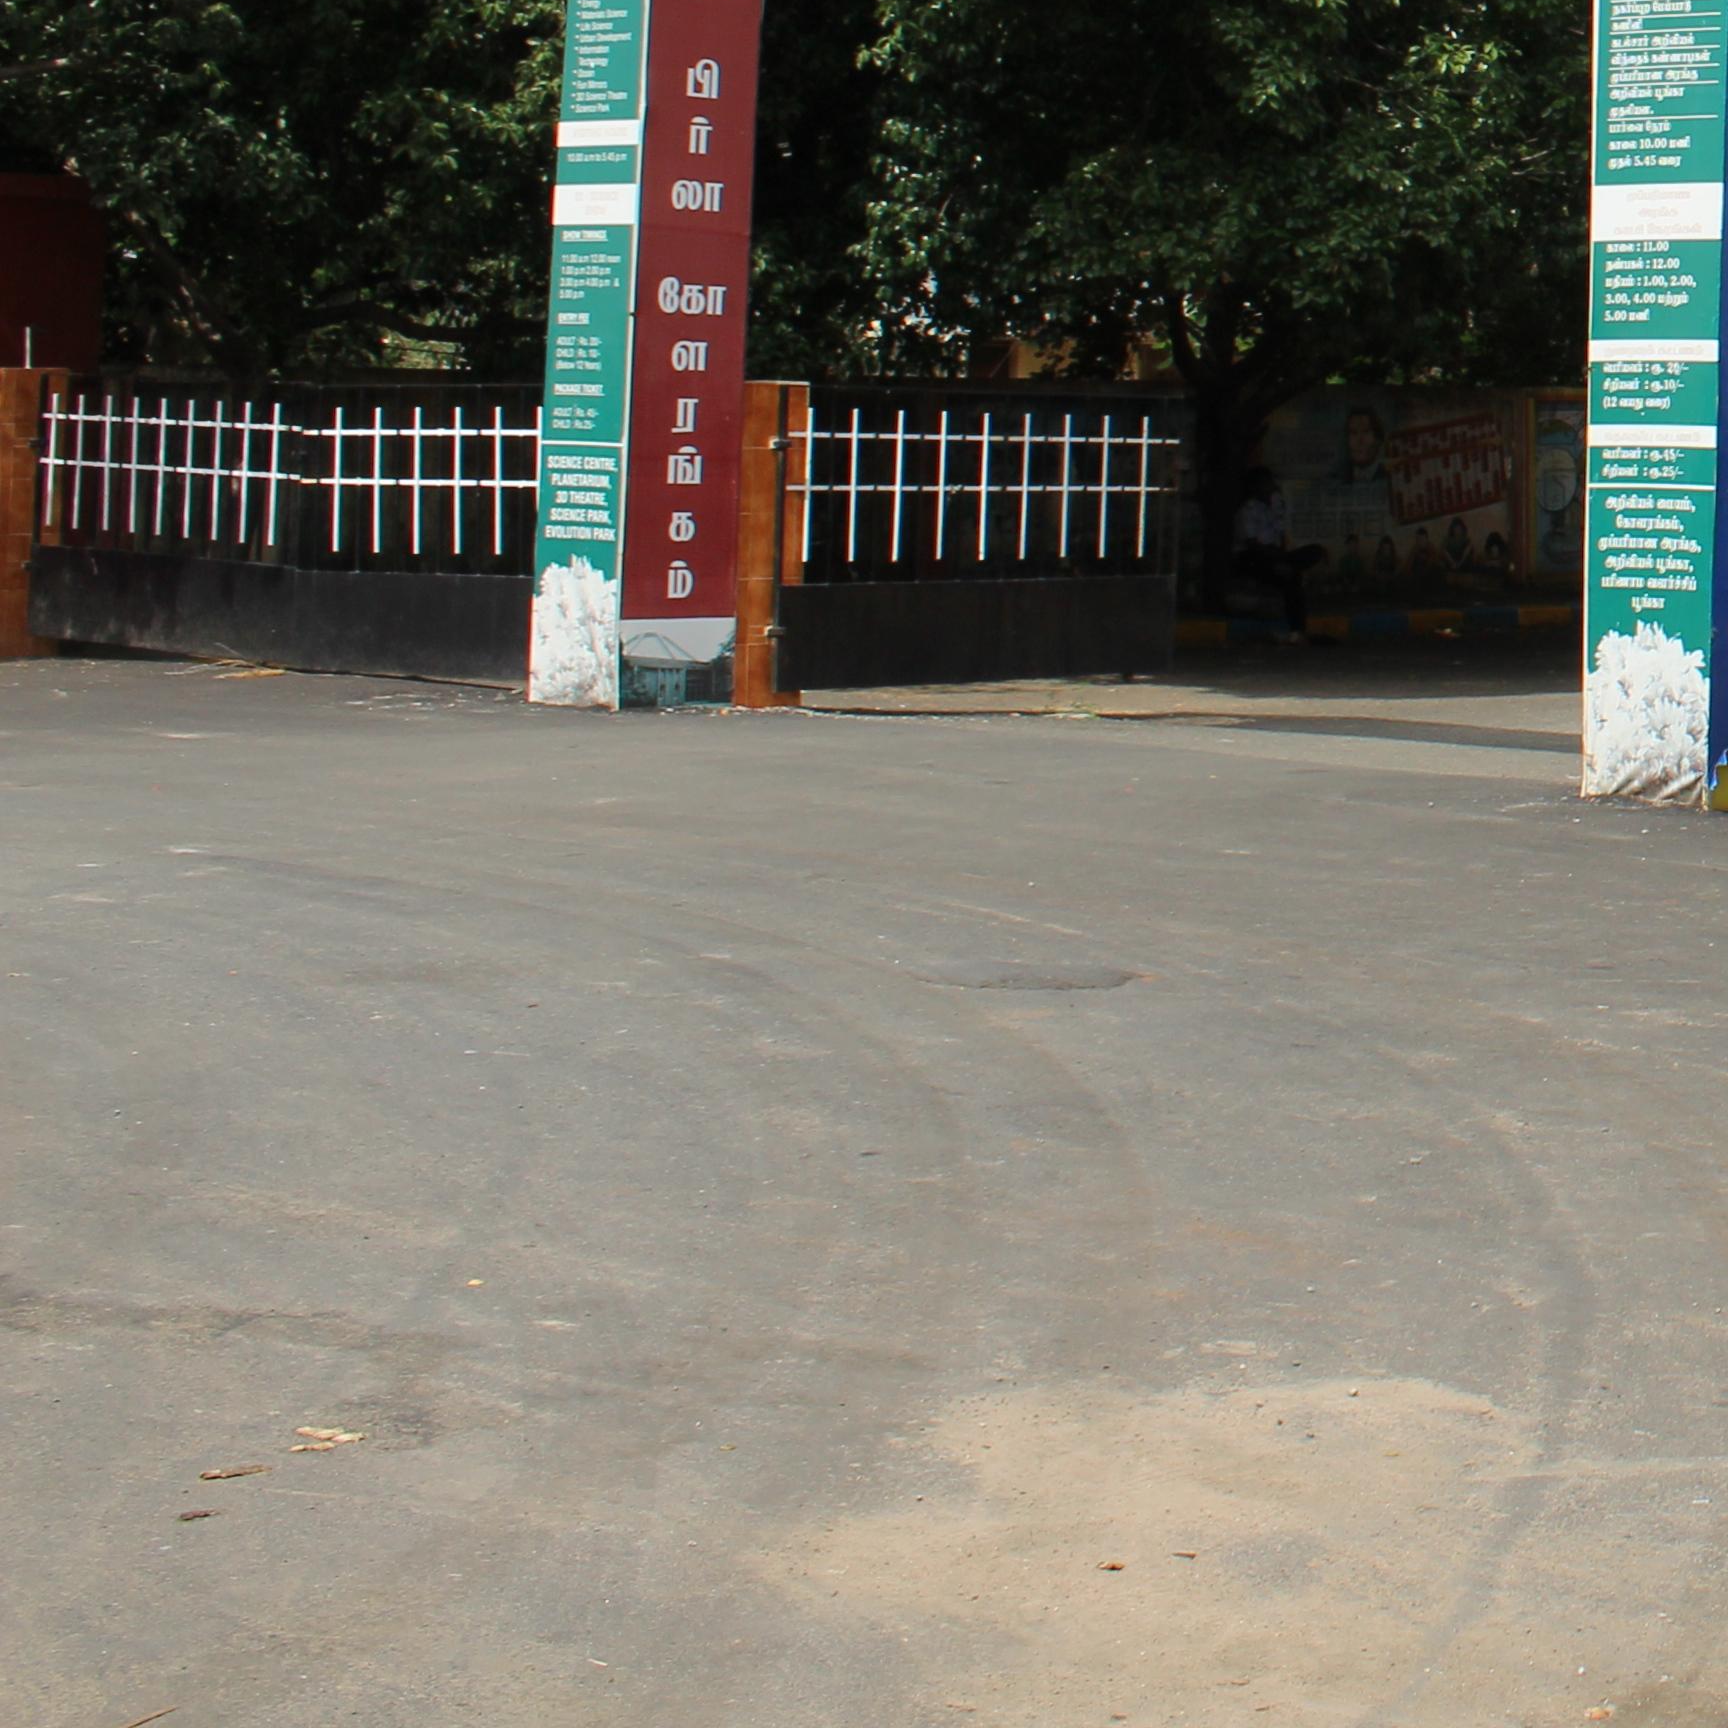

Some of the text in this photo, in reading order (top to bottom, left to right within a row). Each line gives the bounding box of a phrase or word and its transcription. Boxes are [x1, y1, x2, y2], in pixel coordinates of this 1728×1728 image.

[1640, 137, 1667, 149] 10.00
[1634, 155, 1656, 166] 5.45
[1643, 241, 1669, 252] 11.00
[1652, 257, 1680, 269] 12.00
[1604, 309, 1627, 321] 5.00
